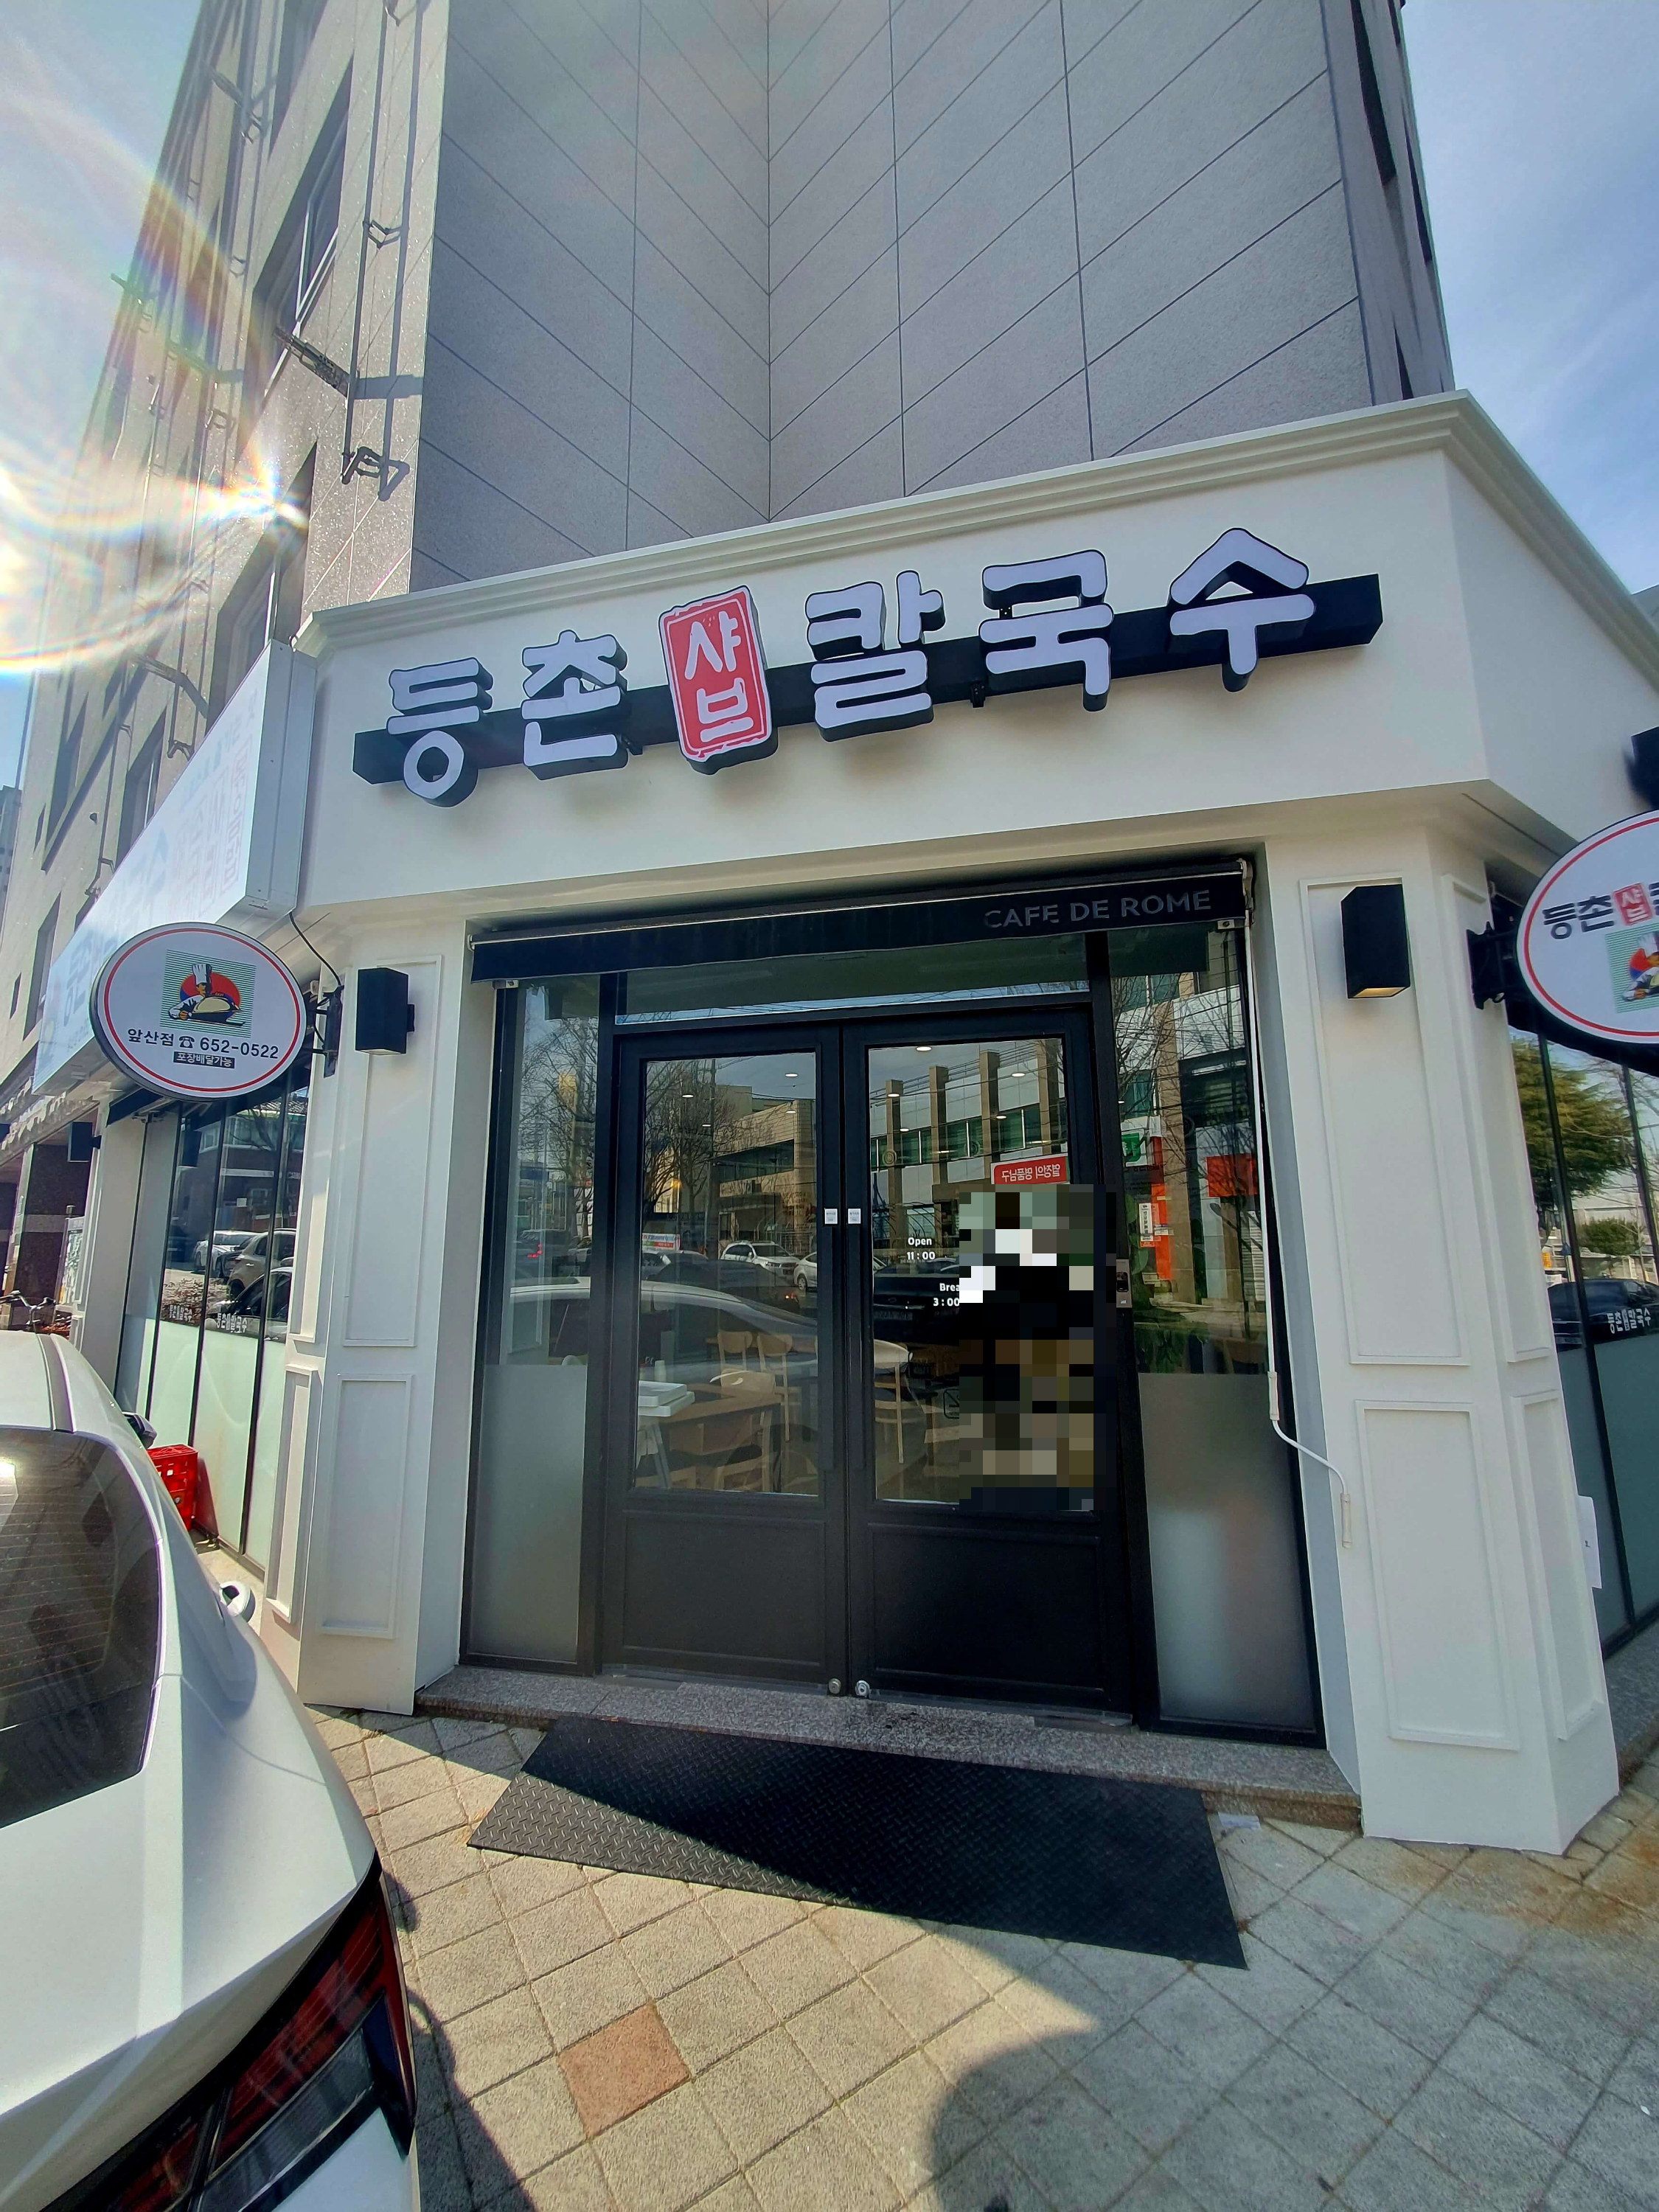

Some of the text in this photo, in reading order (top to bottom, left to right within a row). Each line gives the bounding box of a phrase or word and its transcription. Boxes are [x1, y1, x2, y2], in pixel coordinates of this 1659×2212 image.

[984, 889, 1211, 928] CAFE DE ROME
[128, 1028, 279, 1059] 앞산점 652-0522
[908, 1237, 933, 1248] Open
[939, 1282, 960, 1292] Brea
